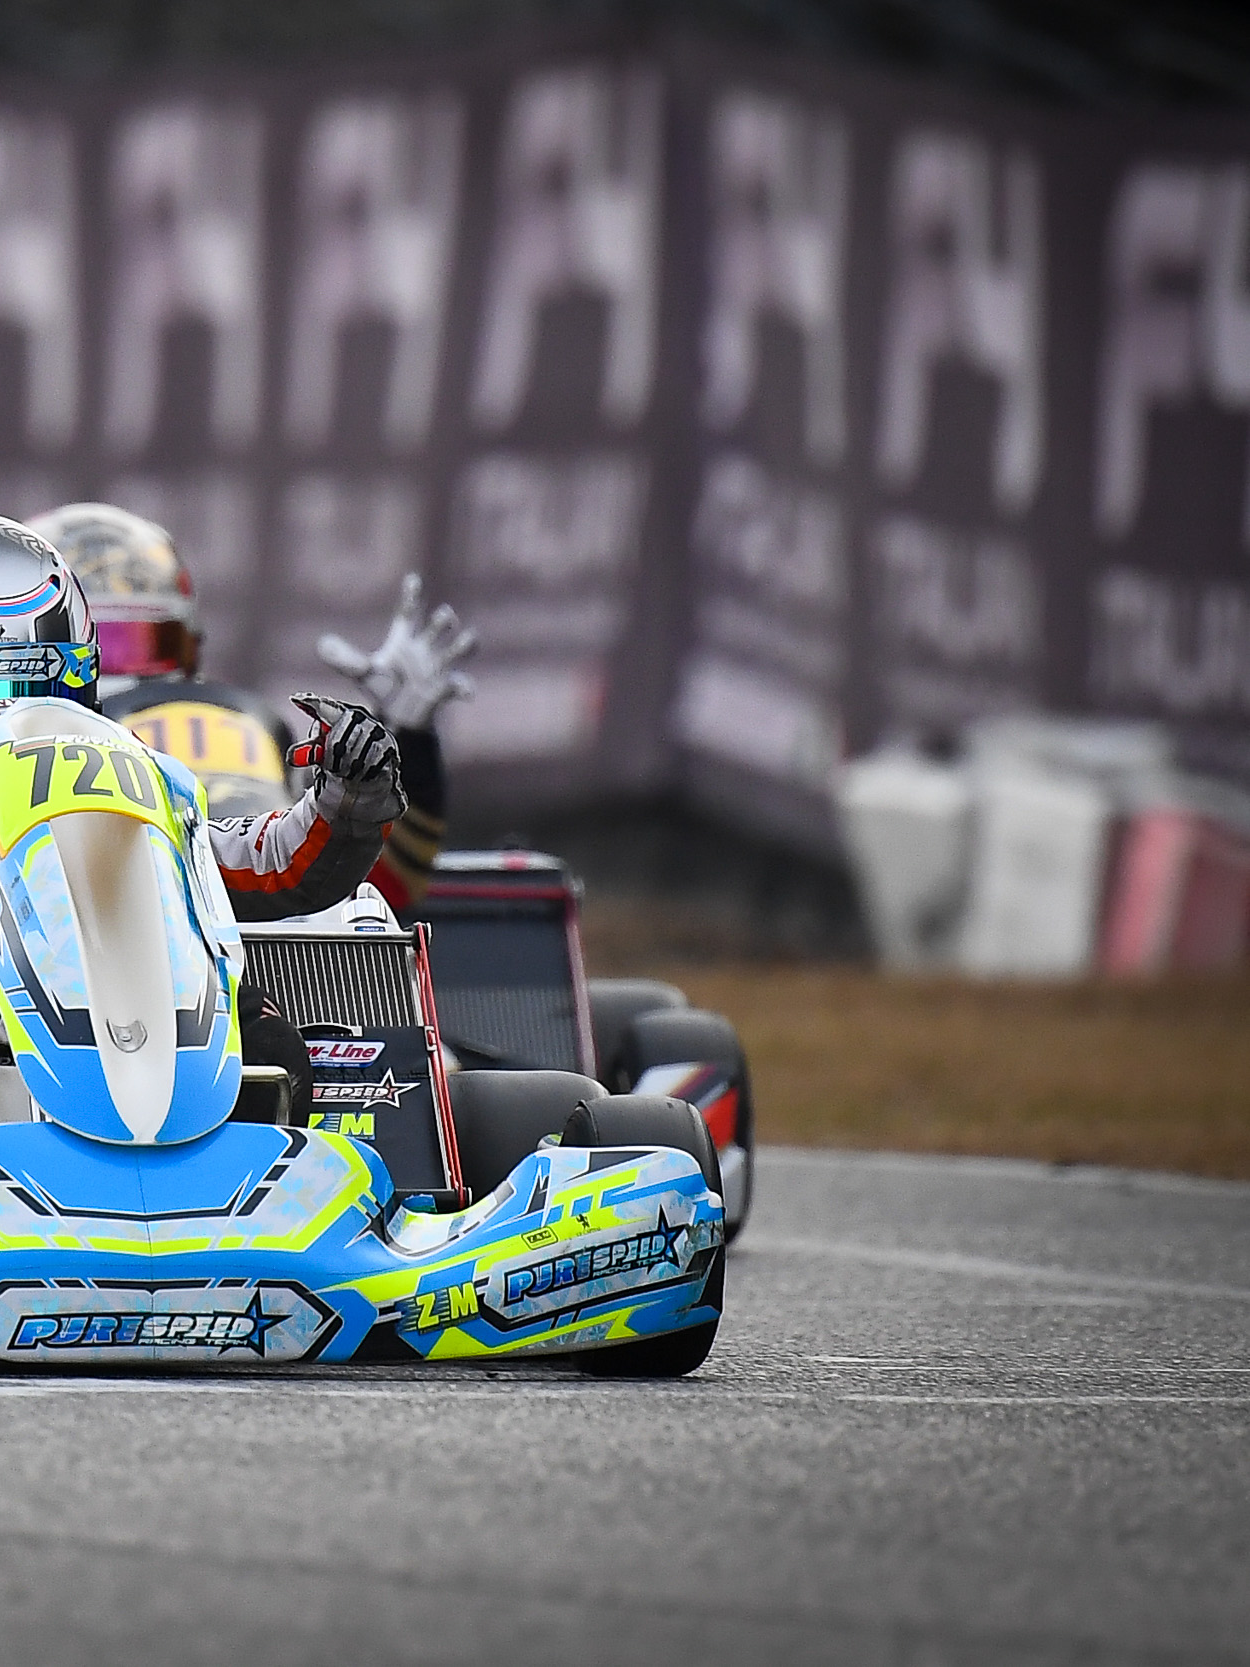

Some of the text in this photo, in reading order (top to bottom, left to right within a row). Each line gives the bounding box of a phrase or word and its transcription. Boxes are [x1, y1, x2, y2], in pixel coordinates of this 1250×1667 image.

[15, 744, 158, 811] 720
[507, 1233, 667, 1301] PURESPEED
[16, 1315, 256, 1345] PURESPEED
[205, 1338, 248, 1346] TEAM
